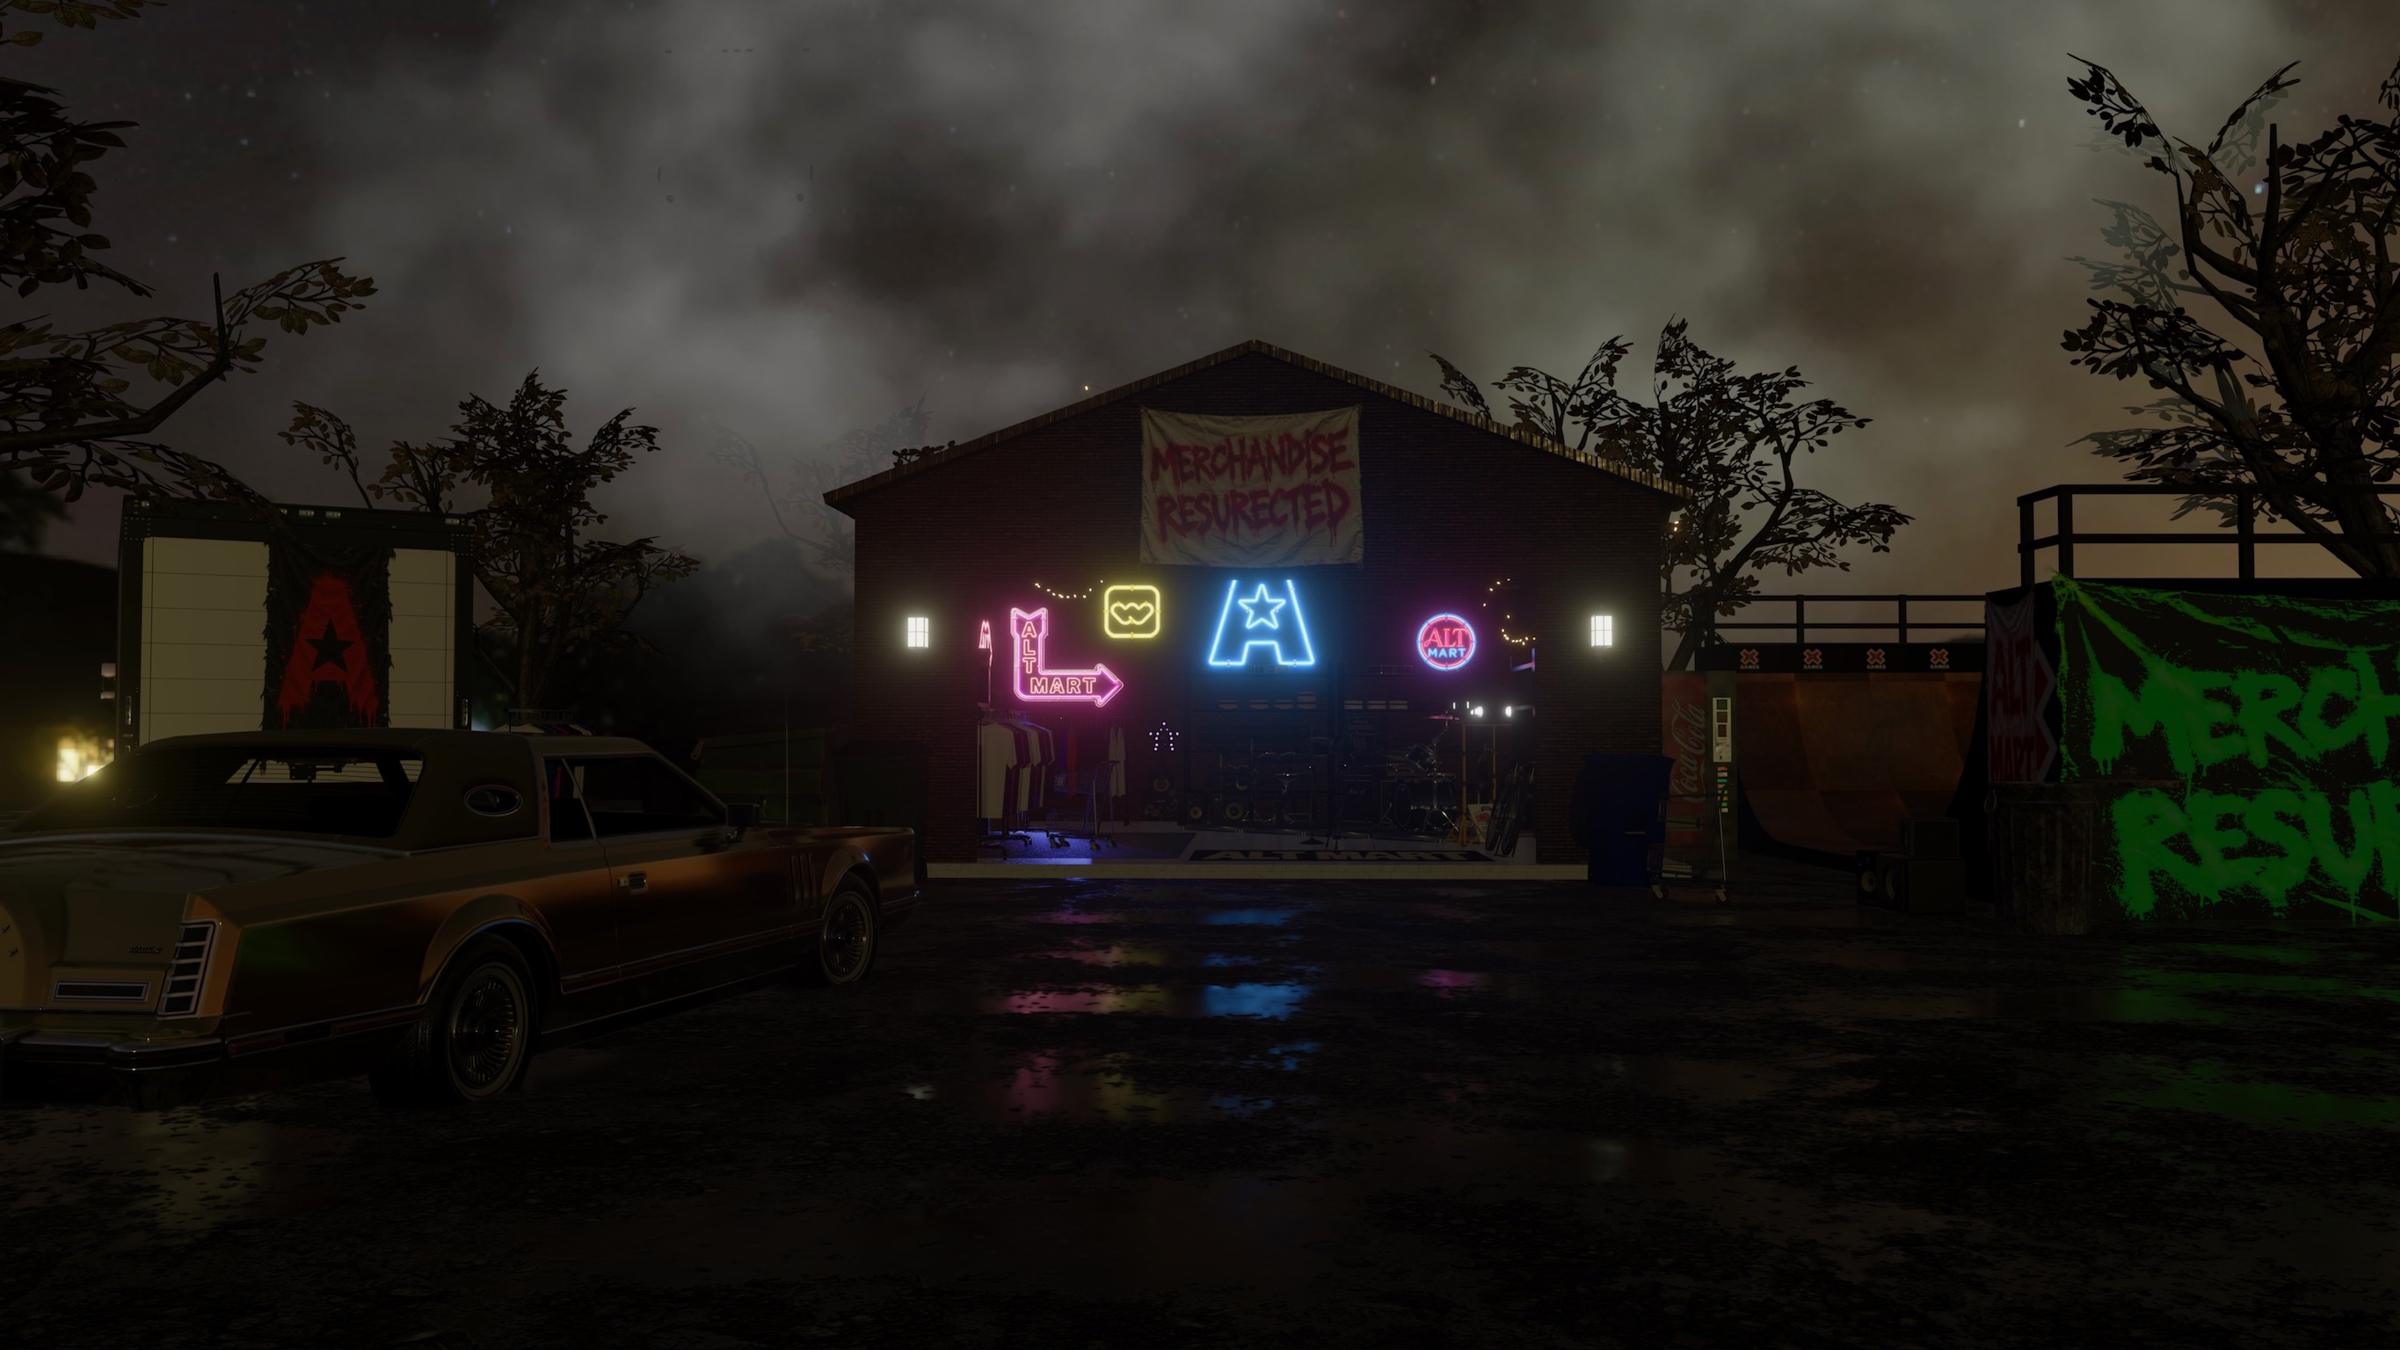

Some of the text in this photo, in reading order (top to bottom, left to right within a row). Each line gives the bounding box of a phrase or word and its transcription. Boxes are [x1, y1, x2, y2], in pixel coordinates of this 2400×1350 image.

[1150, 426, 1354, 486] MERCHANDISE
[1157, 478, 1350, 543] RESURECTED
[1021, 621, 1037, 674] ALT
[1423, 627, 1468, 648] ALT
[1428, 647, 1466, 658] MART
[1030, 677, 1096, 694] MART
